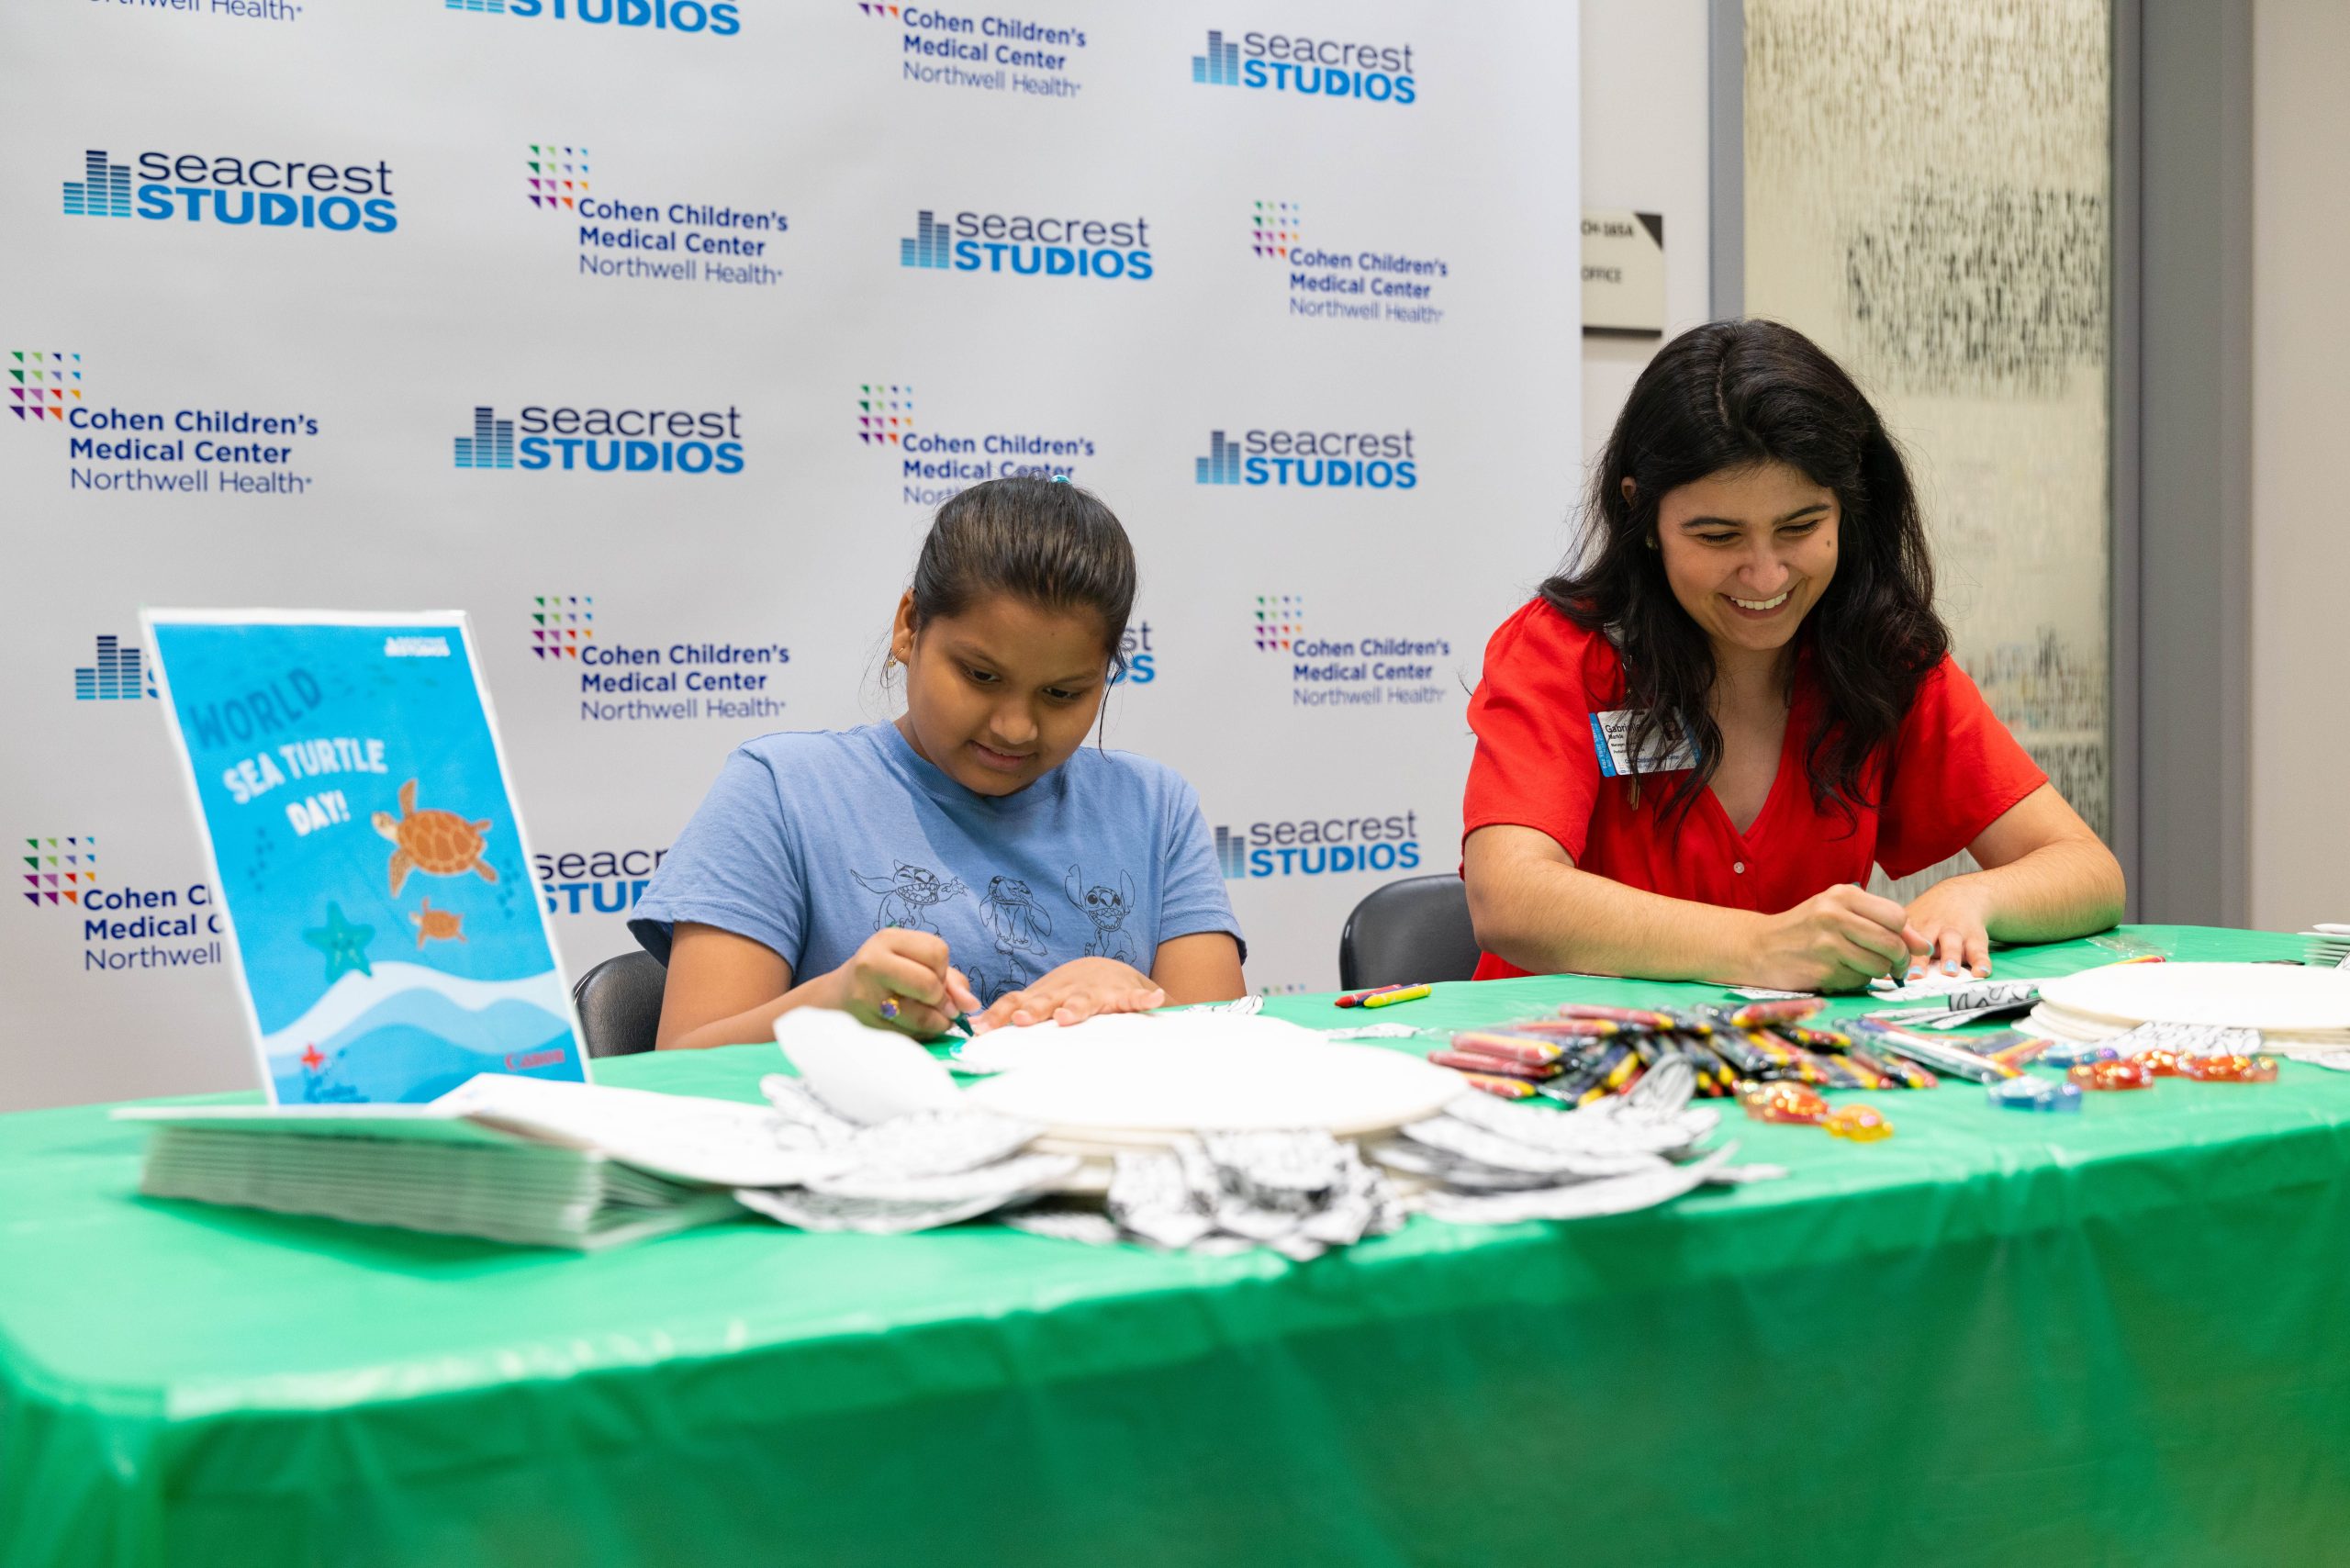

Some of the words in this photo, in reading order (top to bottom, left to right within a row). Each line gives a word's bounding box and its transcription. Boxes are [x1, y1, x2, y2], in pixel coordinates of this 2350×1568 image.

[509, 0, 740, 36] STUDIOS
[903, 7, 974, 33] Cohen
[981, 17, 1086, 47] Children's
[904, 35, 988, 61] Medical
[995, 45, 1065, 70] Center
[1245, 32, 1413, 74] seacrest
[903, 61, 1005, 89] Northwell
[1244, 60, 1416, 105] STUDIOS
[139, 152, 392, 196] seacrest
[137, 185, 397, 233] STUDIOS
[579, 198, 659, 221] Cohen
[668, 204, 788, 231] Children's
[580, 226, 676, 251] Medical
[685, 233, 765, 256] Center
[956, 212, 1148, 248] seacrest
[580, 254, 696, 280] Northwell
[955, 241, 1153, 280] STUDIOS
[1290, 248, 1352, 274] Cohen
[1359, 252, 1448, 276] Children's
[1582, 265, 1621, 284] OFFICE
[1291, 273, 1364, 294] Medical
[1371, 277, 1430, 298] Center
[1290, 297, 1380, 319] Northwell
[70, 408, 163, 431] Cohen
[175, 410, 318, 435] Children's
[520, 407, 740, 439] seacrest
[71, 438, 183, 461] Medical
[195, 441, 291, 463] Center
[519, 437, 744, 474] STUDIOS
[902, 433, 975, 453] Cohen
[984, 435, 1094, 456] Children's
[1246, 430, 1414, 461] seacrest
[72, 468, 207, 492] Northwell
[904, 460, 991, 479] Medical
[1245, 457, 1416, 489] STUDIOS
[581, 645, 660, 666] Cohen
[669, 644, 789, 665] Children's
[1292, 639, 1354, 657] Cohen
[1360, 639, 1449, 656] Children's
[582, 672, 676, 692] Medical
[686, 672, 767, 691] Center
[1293, 664, 1366, 681] Medical
[1372, 663, 1432, 680] Center
[188, 667, 322, 749] WORLD
[581, 699, 697, 721] Northwell
[1293, 687, 1382, 706] Northwell
[223, 752, 285, 804] SEA
[279, 737, 388, 779] TURTLE
[285, 790, 351, 836] DAY!
[1250, 811, 1416, 848] seacrest
[533, 848, 668, 879] seacr
[1249, 842, 1420, 878] STUDIOS
[84, 888, 176, 911] Cohen
[85, 914, 196, 940] Medical
[85, 943, 220, 970] Northwell
